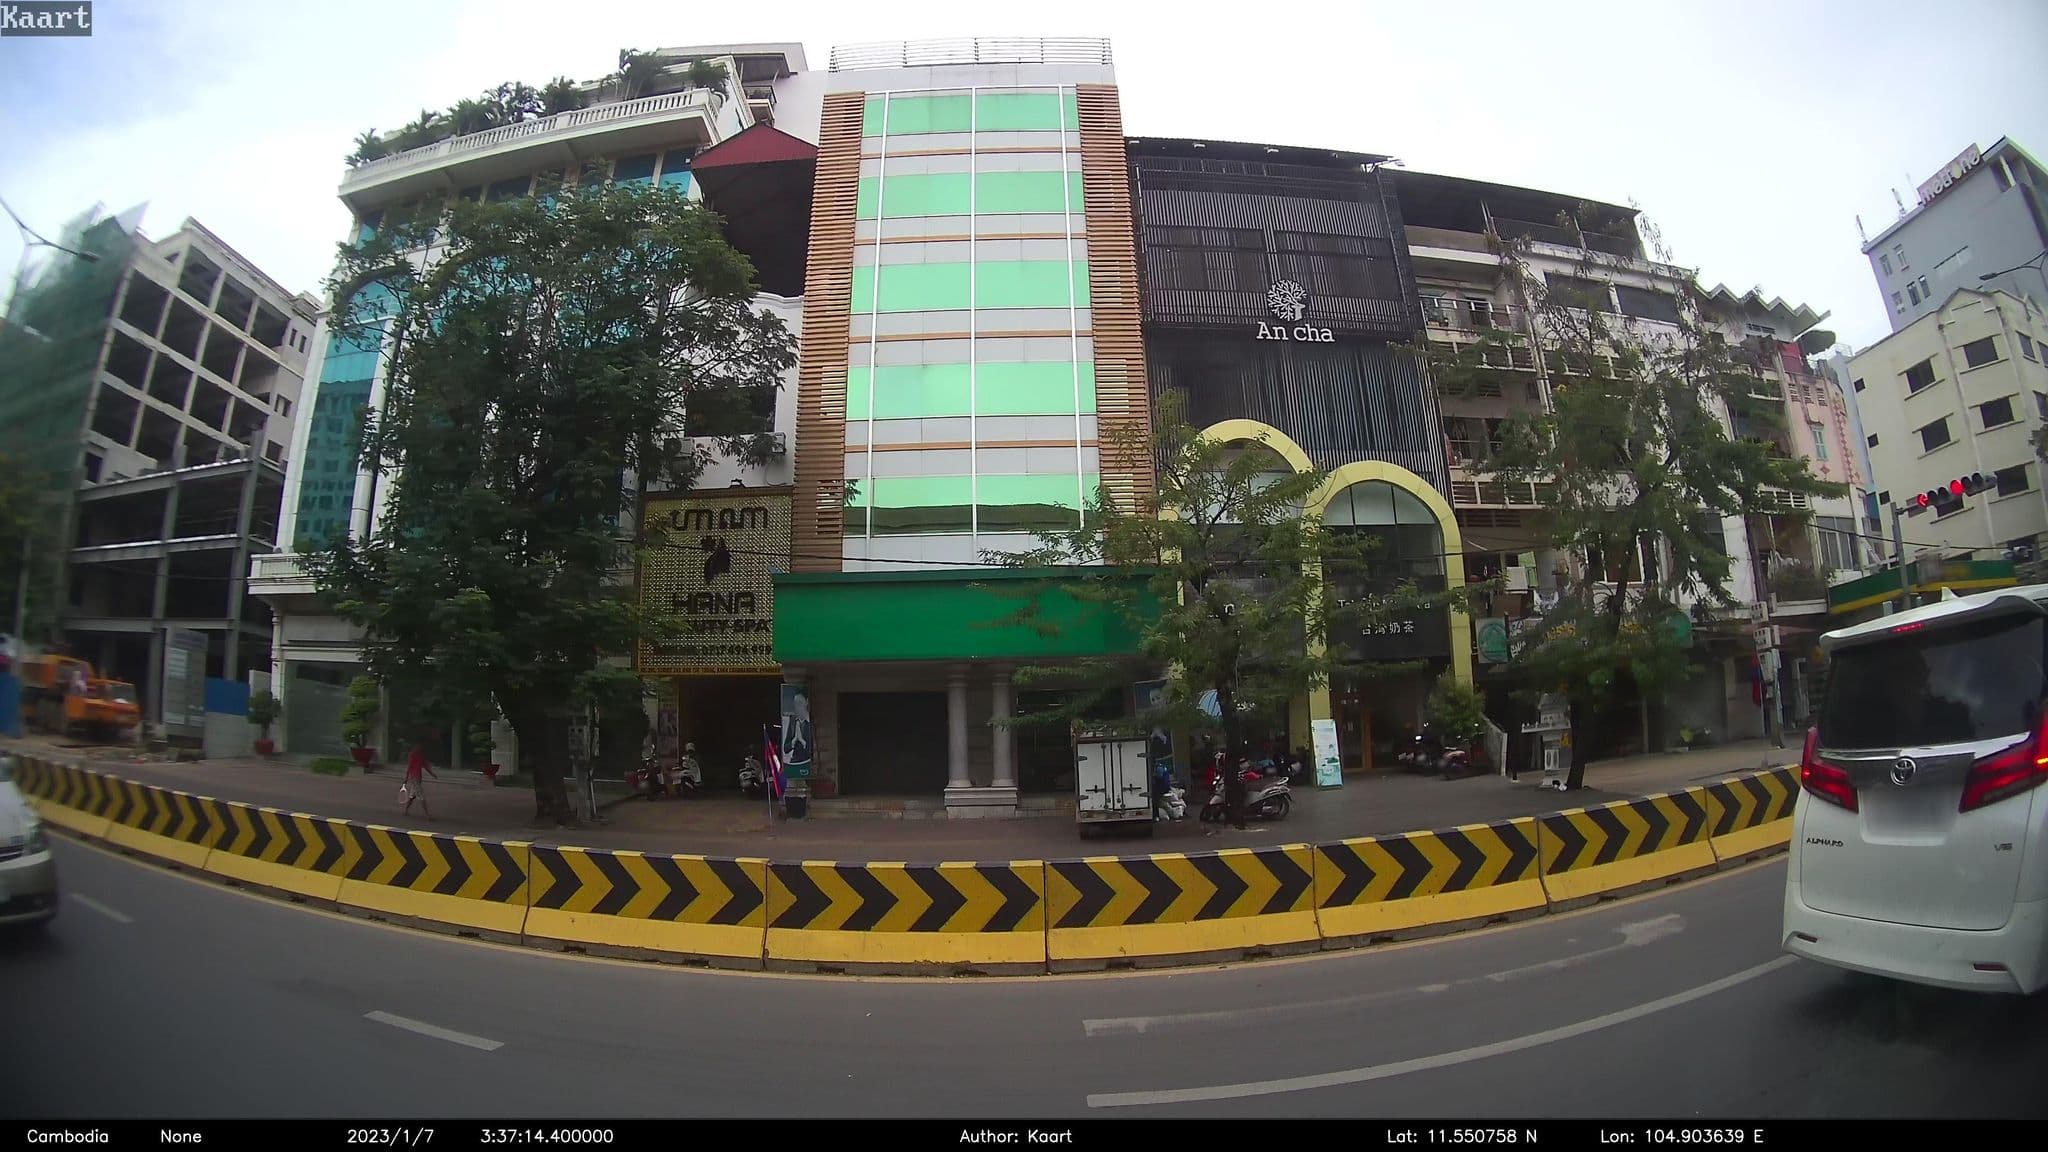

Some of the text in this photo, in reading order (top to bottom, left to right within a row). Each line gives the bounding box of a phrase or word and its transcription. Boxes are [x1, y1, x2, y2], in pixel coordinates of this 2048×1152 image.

[1256, 321, 1335, 342] An cha
[671, 591, 755, 614] HANA
